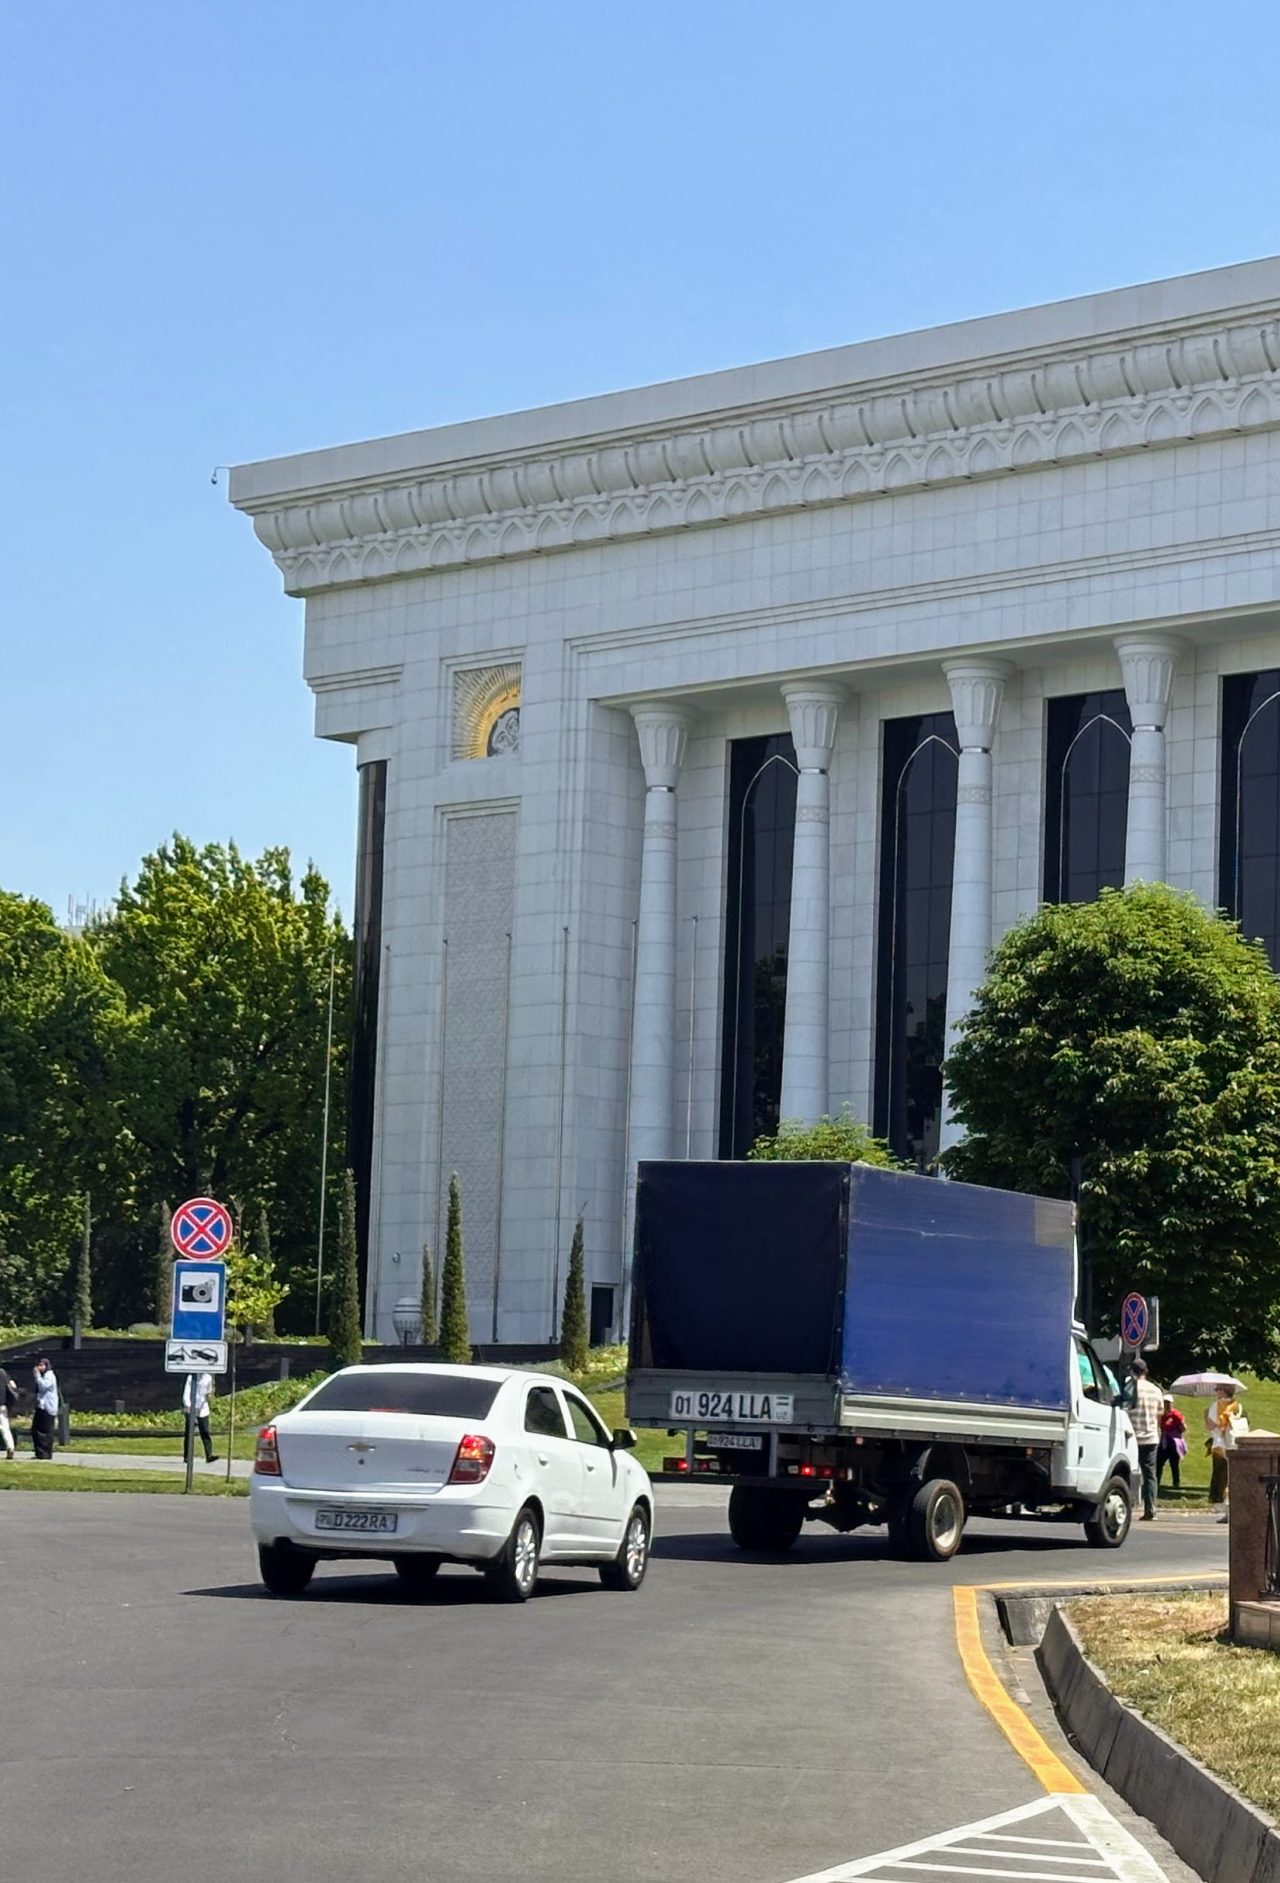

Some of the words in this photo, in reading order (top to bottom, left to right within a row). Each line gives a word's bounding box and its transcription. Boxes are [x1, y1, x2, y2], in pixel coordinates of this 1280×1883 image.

[675, 1395, 691, 1415] 01
[698, 1393, 733, 1418] 924
[739, 1394, 772, 1420] LLA
